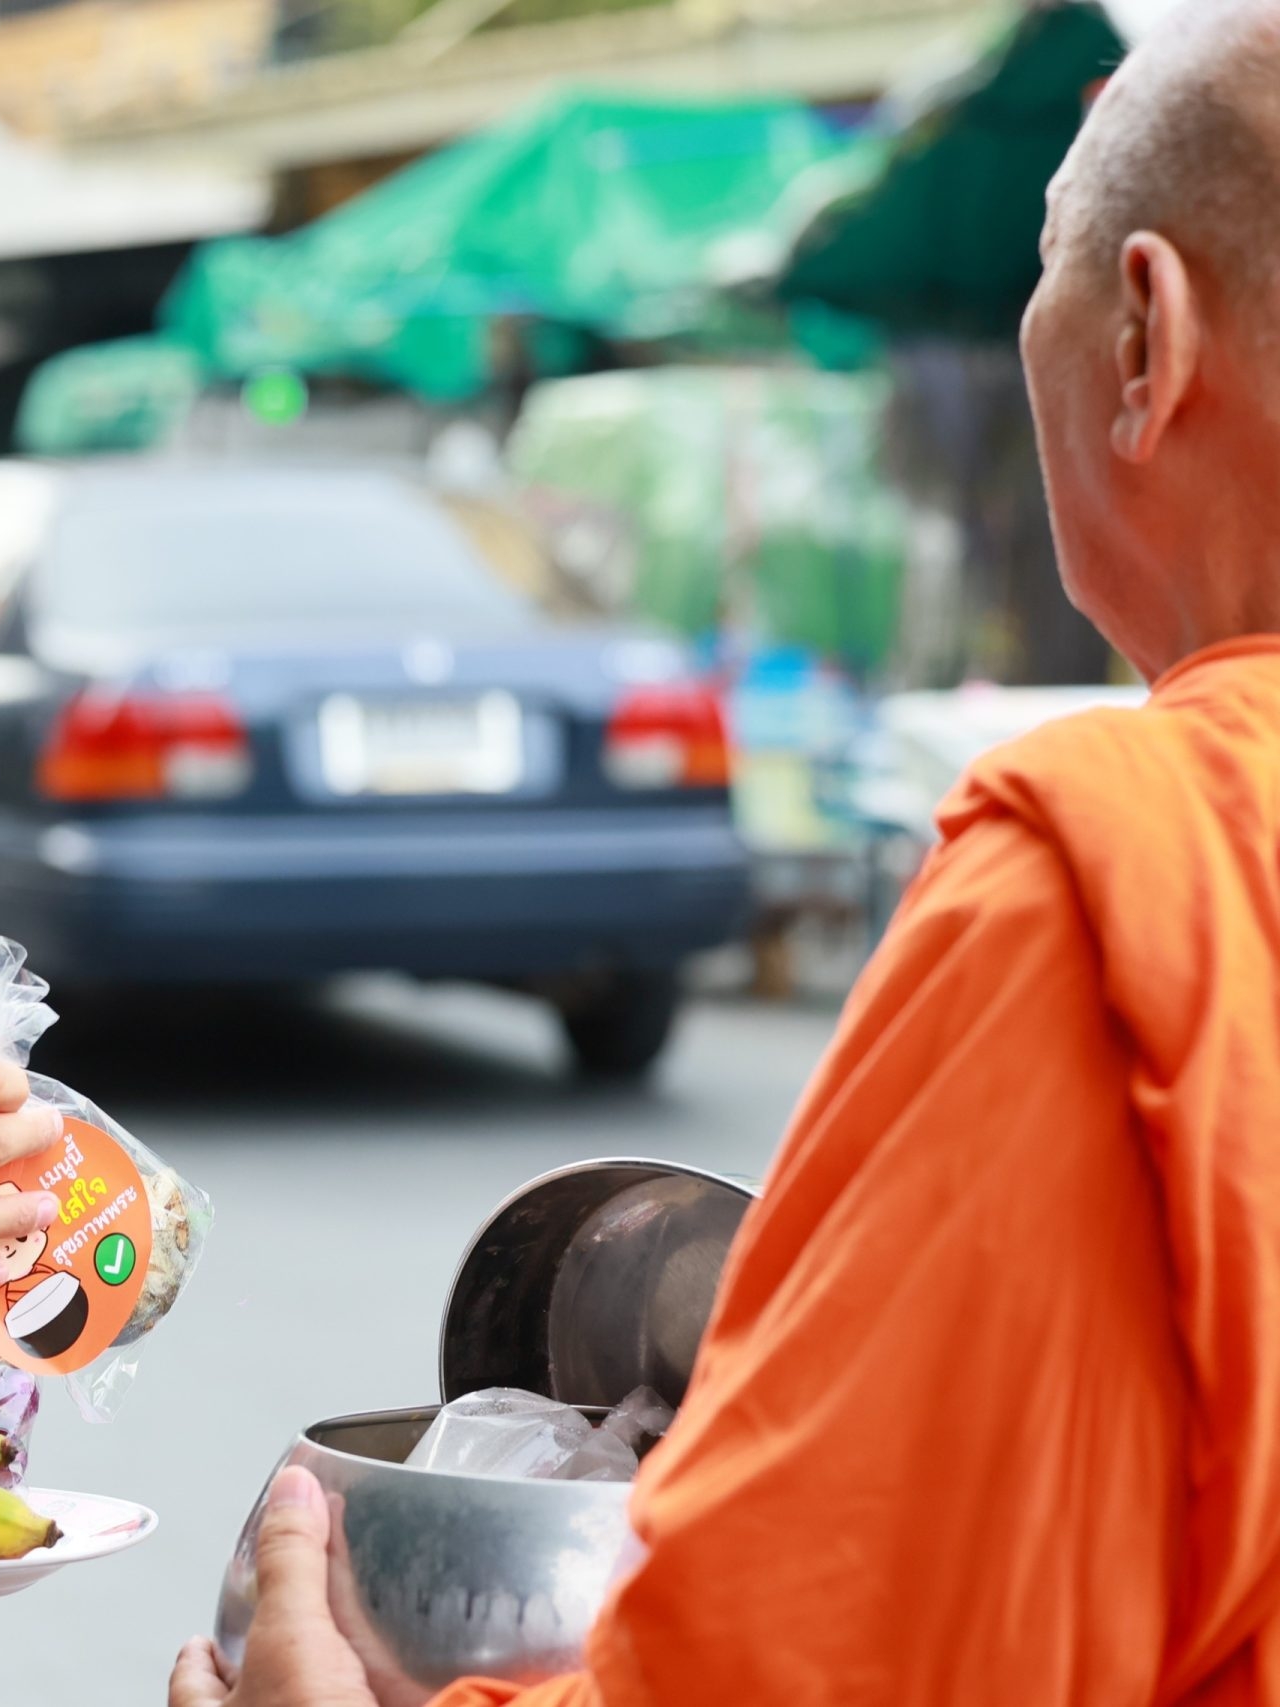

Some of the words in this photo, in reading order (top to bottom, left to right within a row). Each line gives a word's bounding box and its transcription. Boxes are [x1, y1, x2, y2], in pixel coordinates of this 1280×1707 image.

[38, 1133, 84, 1190] เมนูนี้
[52, 1185, 137, 1267] สุขภาพพระ
